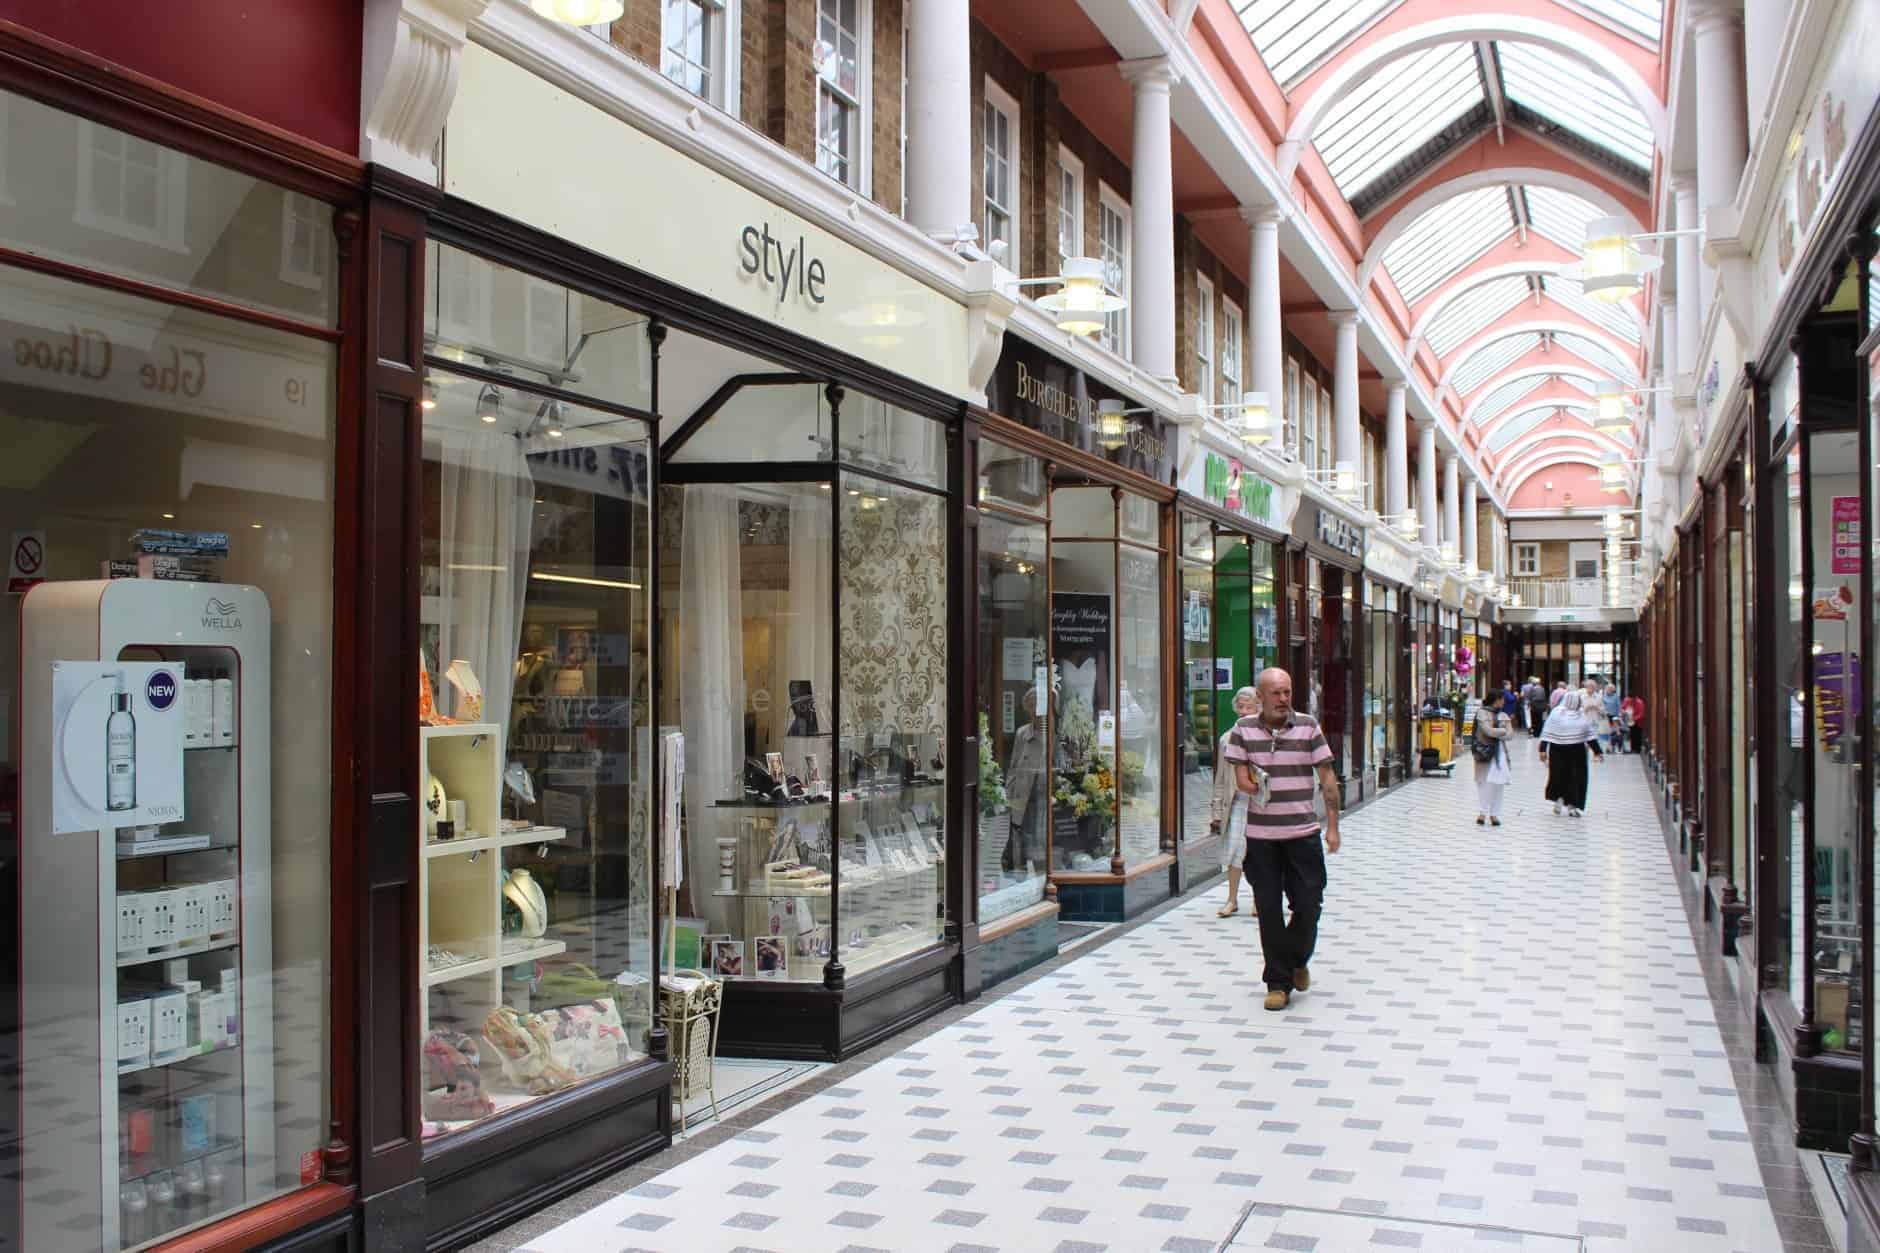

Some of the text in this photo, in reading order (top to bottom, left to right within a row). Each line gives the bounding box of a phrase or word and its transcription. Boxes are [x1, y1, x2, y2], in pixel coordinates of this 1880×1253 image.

[741, 222, 825, 303] style
[201, 617, 242, 629] WELLA
[148, 685, 176, 697] NEW
